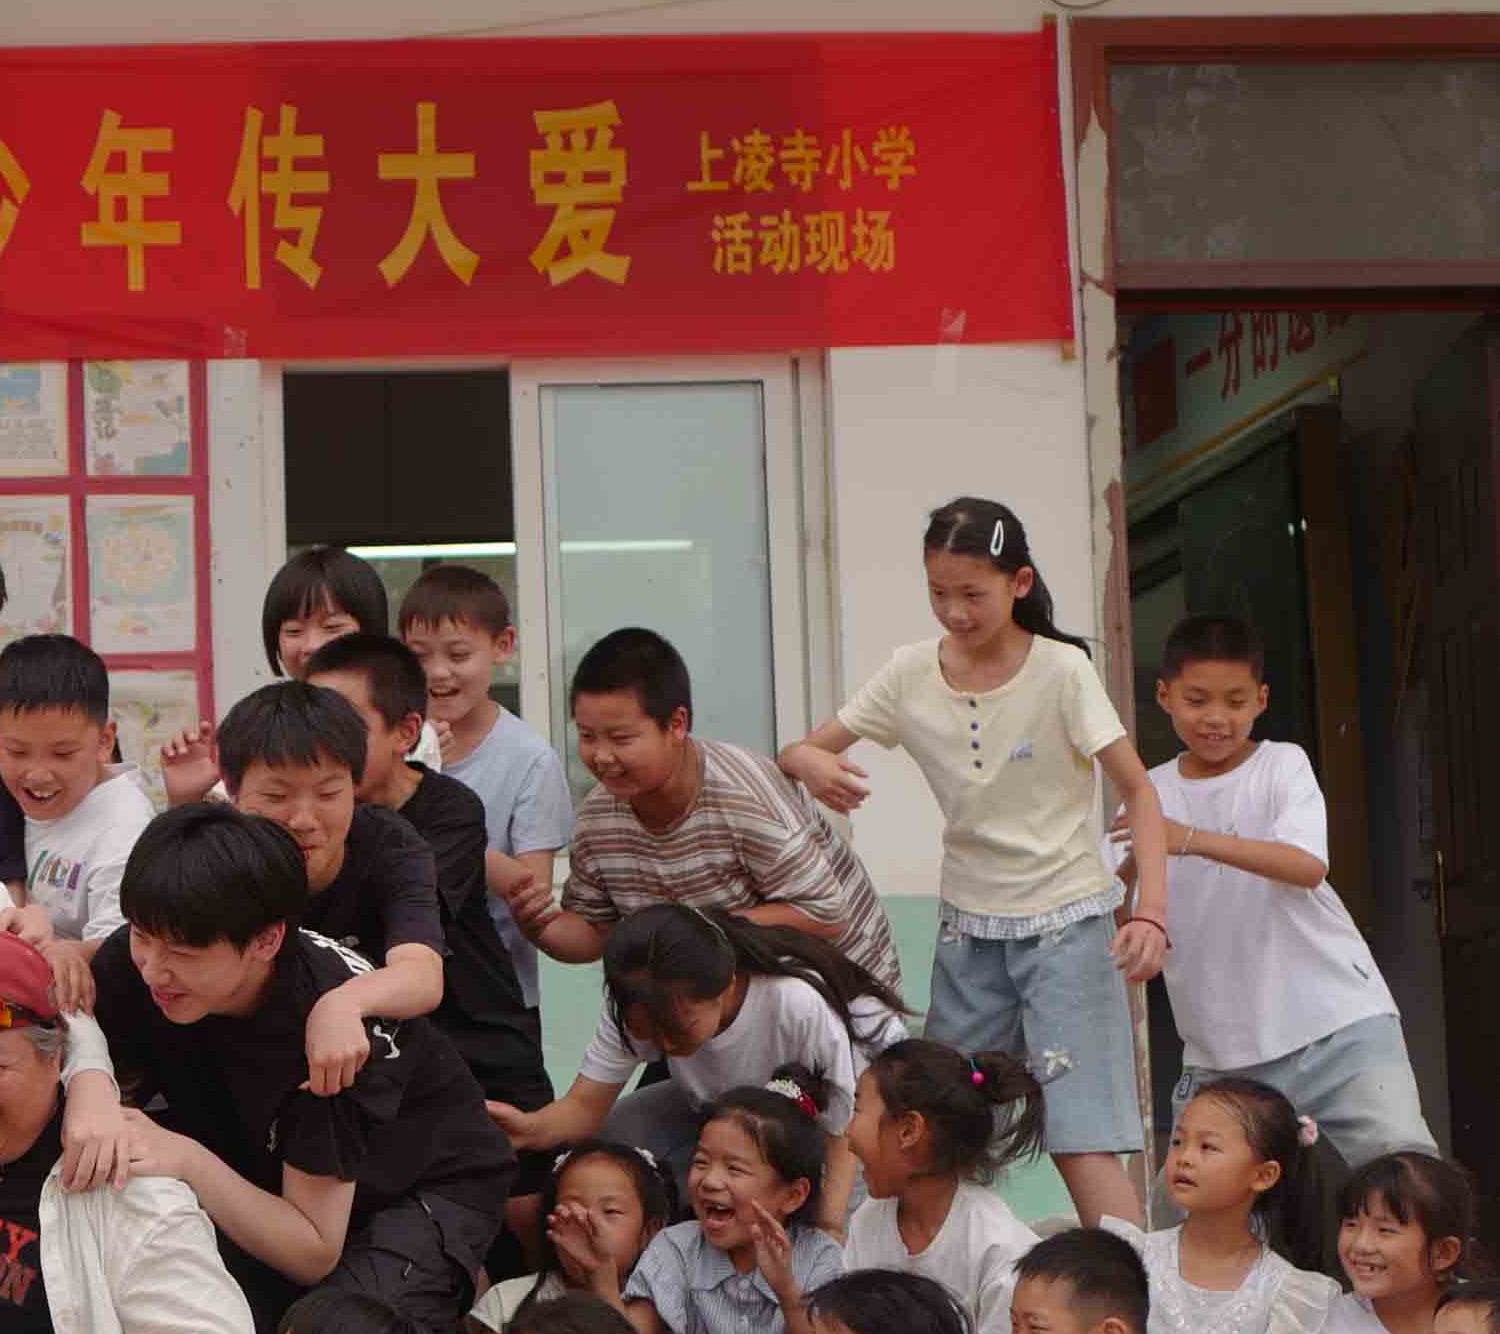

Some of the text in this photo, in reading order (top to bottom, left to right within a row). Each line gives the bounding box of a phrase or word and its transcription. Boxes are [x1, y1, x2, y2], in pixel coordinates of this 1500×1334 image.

[686, 126, 918, 193] 上凌寺小学
[711, 207, 897, 275] 活动现场
